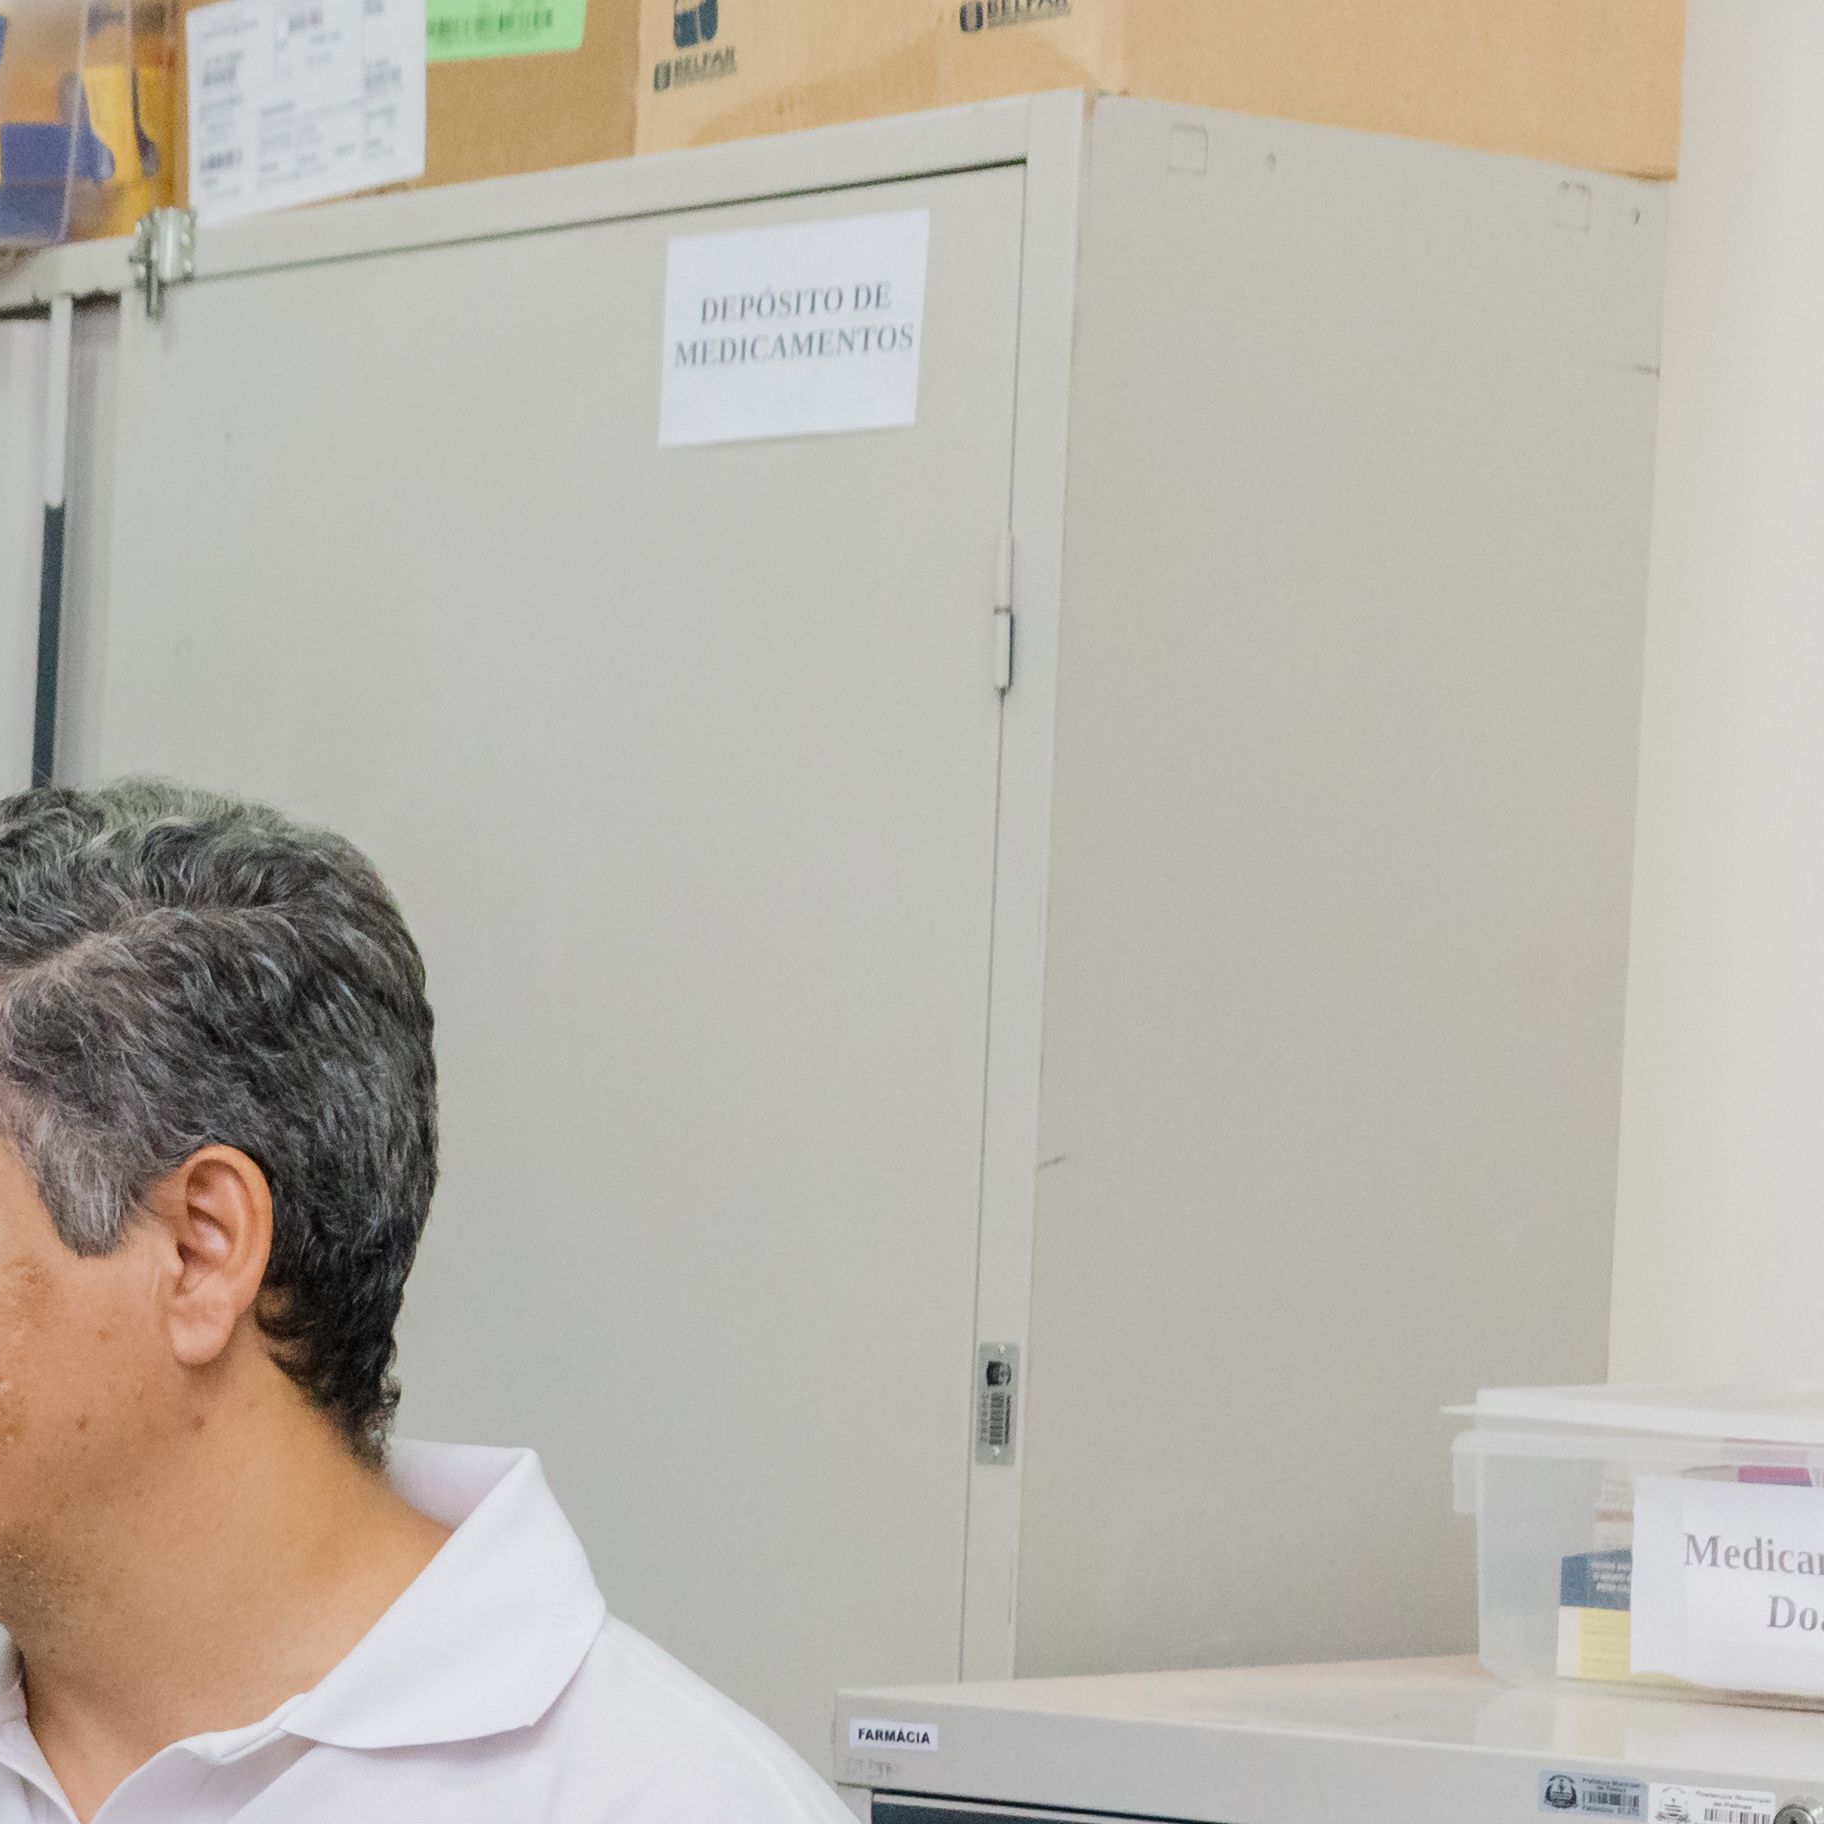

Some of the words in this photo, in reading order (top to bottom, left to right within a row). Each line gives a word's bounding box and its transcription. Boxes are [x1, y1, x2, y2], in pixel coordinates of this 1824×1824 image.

[701, 284, 844, 324] DEPÓSITO
[853, 281, 893, 312] DE
[673, 322, 914, 369] MEDICAMENTOS
[1767, 1594, 1824, 1632] Do
[858, 1727, 930, 1744] FARMÁCIA
